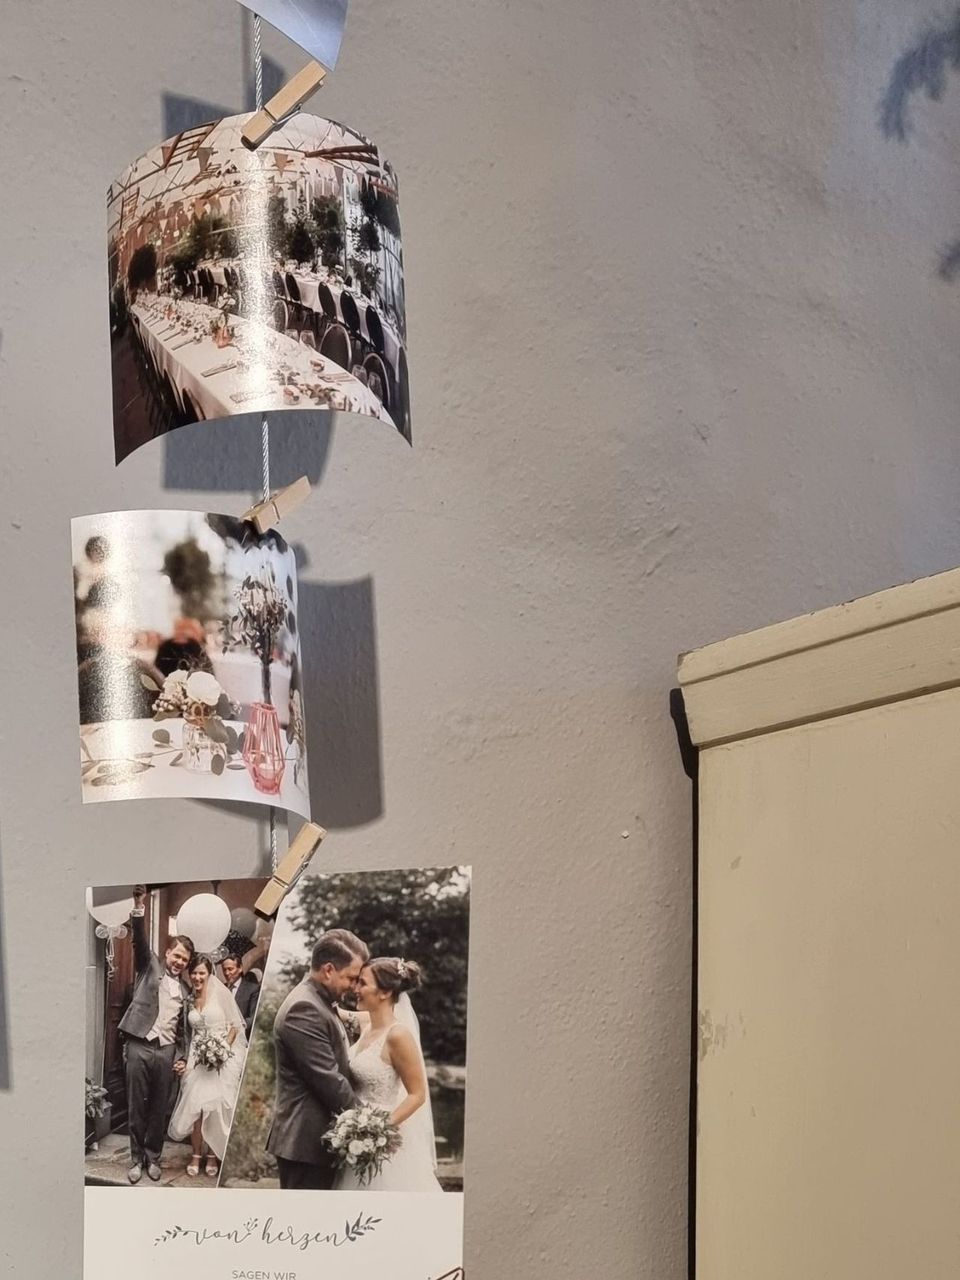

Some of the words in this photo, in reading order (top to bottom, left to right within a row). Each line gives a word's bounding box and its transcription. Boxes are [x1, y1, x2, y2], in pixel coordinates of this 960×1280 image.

[187, 1228, 251, 1245] von
[261, 1216, 348, 1251] herzen
[232, 1270, 270, 1280] SAGEN
[273, 1272, 296, 1280] WIR
